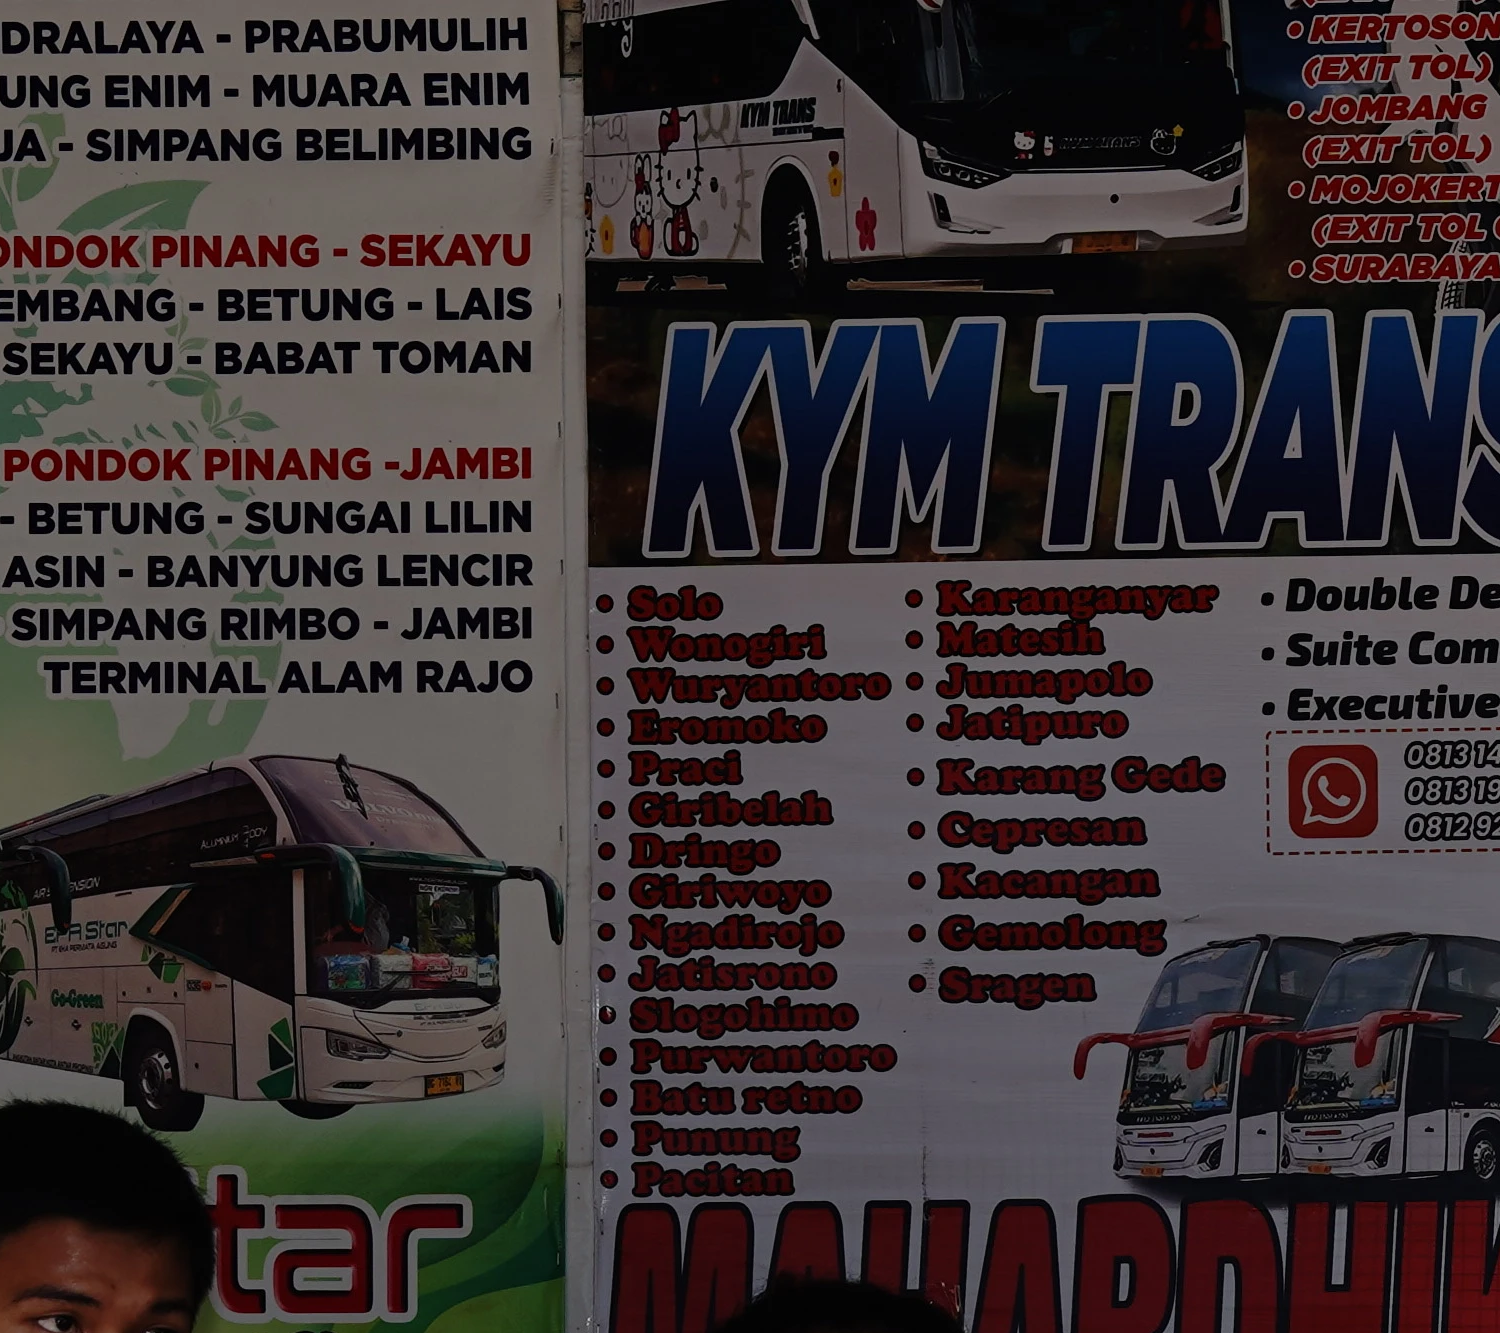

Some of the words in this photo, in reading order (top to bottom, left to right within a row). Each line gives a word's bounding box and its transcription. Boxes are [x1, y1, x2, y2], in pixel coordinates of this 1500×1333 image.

[245, 17, 527, 53] PRABUMULIH
[1310, 94, 1487, 124] JOMBANG
[1313, 215, 1410, 247] (EXIT
[1418, 214, 1487, 243] TOL
[153, 235, 319, 267] PINANG
[360, 234, 530, 267] SEKAYU
[218, 288, 394, 321] BETUNG
[436, 287, 532, 320] LAIS
[643, 317, 1004, 557] KYM
[628, 586, 724, 621] Solo
[936, 580, 1218, 620] Karanganyar
[1286, 577, 1439, 612] Double
[628, 626, 825, 666] Wonogiri
[1286, 631, 1398, 666] Suite
[44, 661, 266, 693] TERMINAL
[278, 661, 402, 693] ALAM
[417, 660, 533, 693] RAJO
[628, 668, 892, 709] Wuryantoro
[1287, 684, 1500, 721] Executive
[628, 711, 827, 745] Eromoko
[1404, 740, 1472, 771] 0813
[630, 1040, 898, 1079] Purwantoro
[213, 1174, 463, 1314] tar
